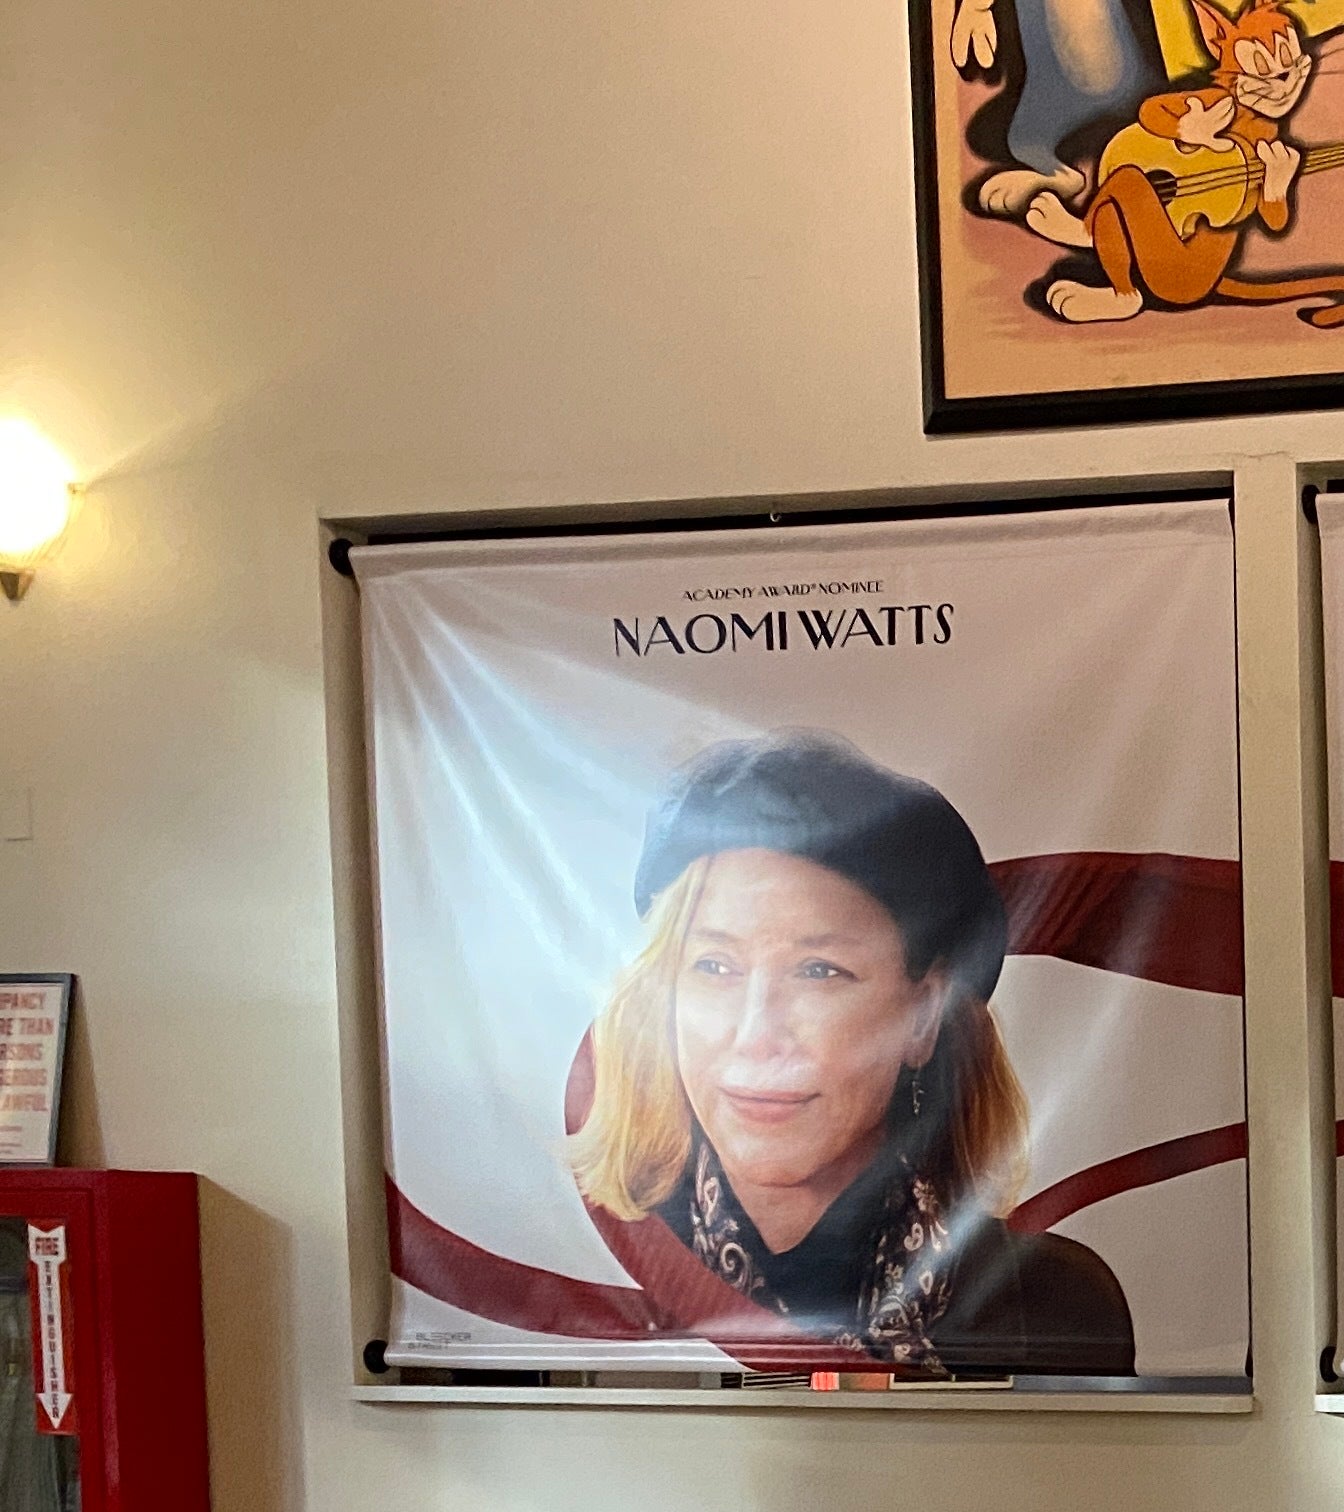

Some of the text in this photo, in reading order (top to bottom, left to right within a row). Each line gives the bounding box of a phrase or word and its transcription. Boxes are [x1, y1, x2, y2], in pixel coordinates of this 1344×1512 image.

[681, 585, 754, 602] ACADEMY
[819, 580, 884, 596] NOMINEE
[613, 603, 955, 659] NAOMI WATTS
